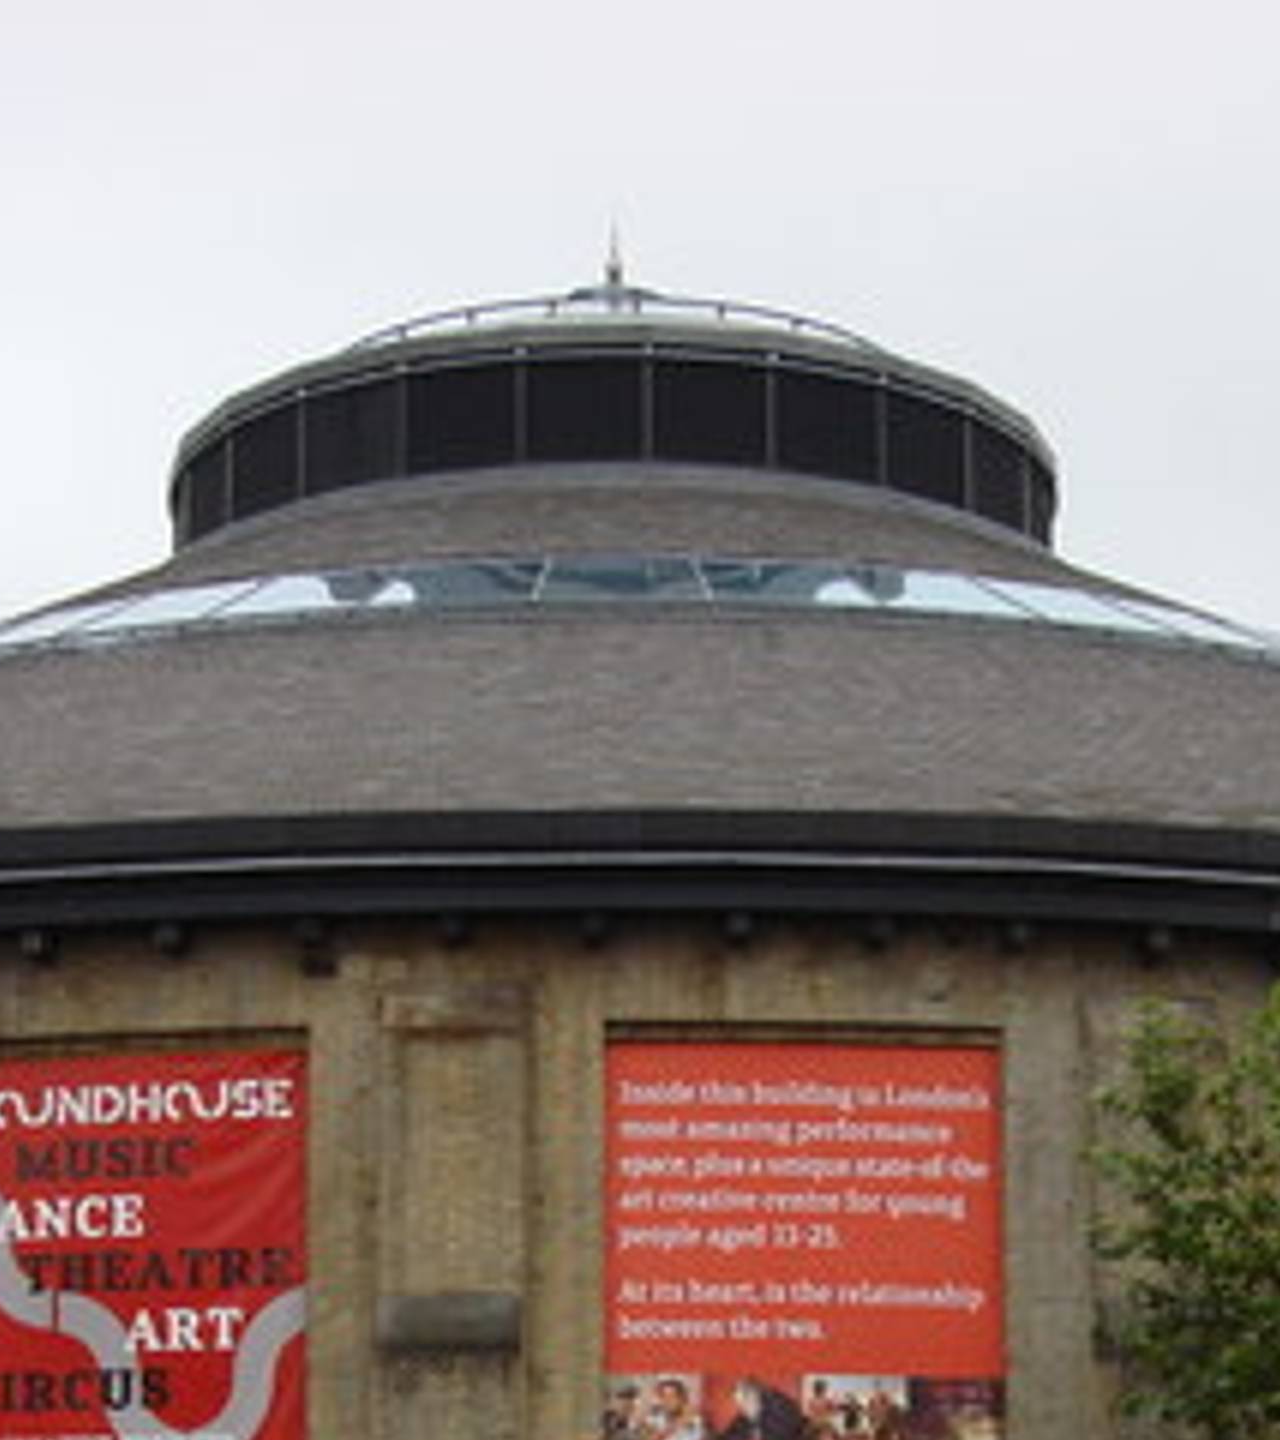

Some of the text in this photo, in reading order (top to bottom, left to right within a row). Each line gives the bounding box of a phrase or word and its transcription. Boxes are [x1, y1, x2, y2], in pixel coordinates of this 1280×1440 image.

[619, 1080, 695, 1105] Inside
[699, 1080, 749, 1105] this
[753, 1080, 853, 1112] building
[886, 1082, 990, 1111] London's
[619, 1117, 953, 1147] most amazing performance
[15, 1137, 193, 1182] MUSIC
[693, 1153, 746, 1182] plus
[767, 1156, 852, 1184] unique
[619, 1188, 966, 1222] art creative centre for young
[619, 1221, 703, 1251] people
[706, 1222, 767, 1253] aged
[21, 1247, 293, 1295] THEATRE
[619, 1277, 647, 1304] At
[790, 1278, 834, 1305] the
[837, 1278, 986, 1314] relationship
[125, 1307, 245, 1352] ART
[618, 1312, 724, 1340] between
[729, 1313, 770, 1340] the
